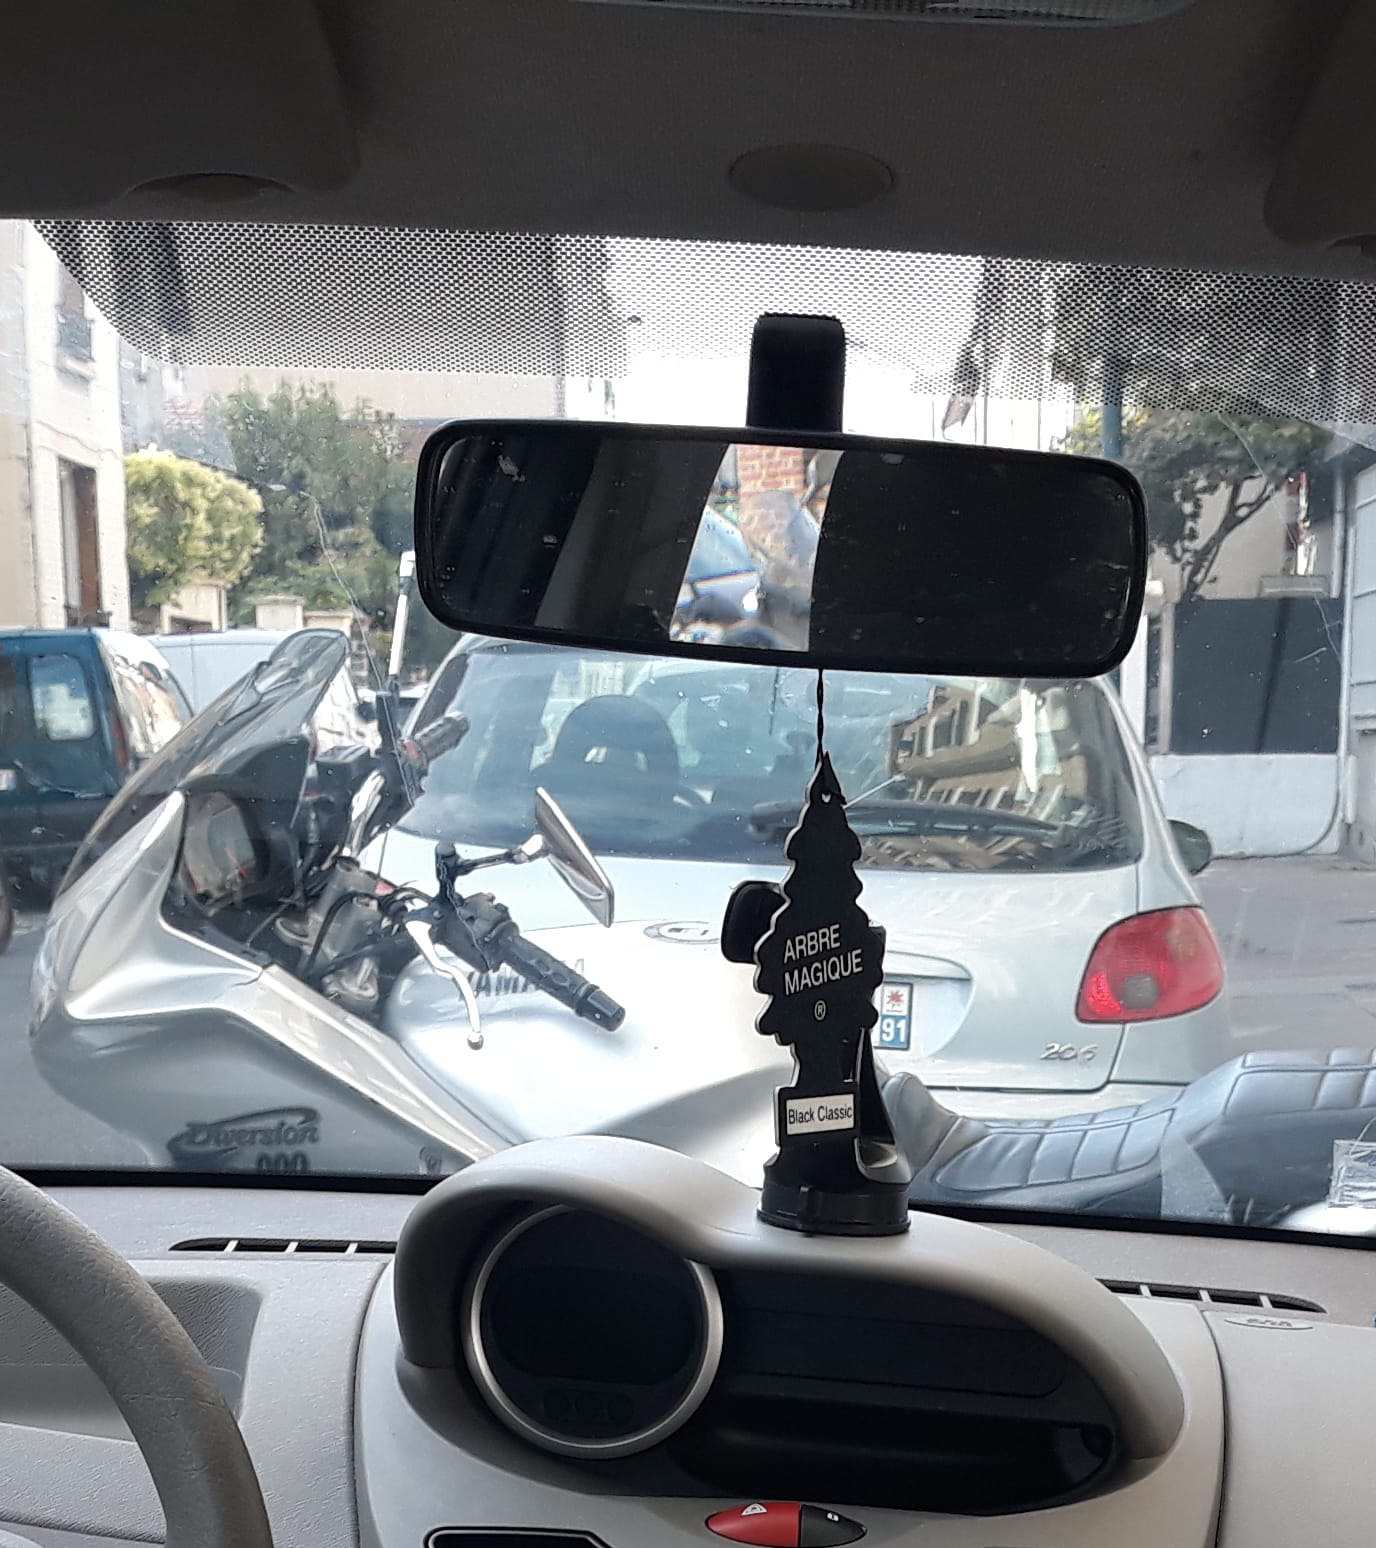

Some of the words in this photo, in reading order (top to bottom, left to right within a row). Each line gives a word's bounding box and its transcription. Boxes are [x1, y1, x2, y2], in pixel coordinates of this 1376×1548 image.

[784, 923, 841, 964] ARBRE
[784, 948, 863, 996] MAGIQUE
[881, 1018, 907, 1043] 91
[788, 1107, 815, 1125] Black
[817, 1104, 853, 1122] Classic
